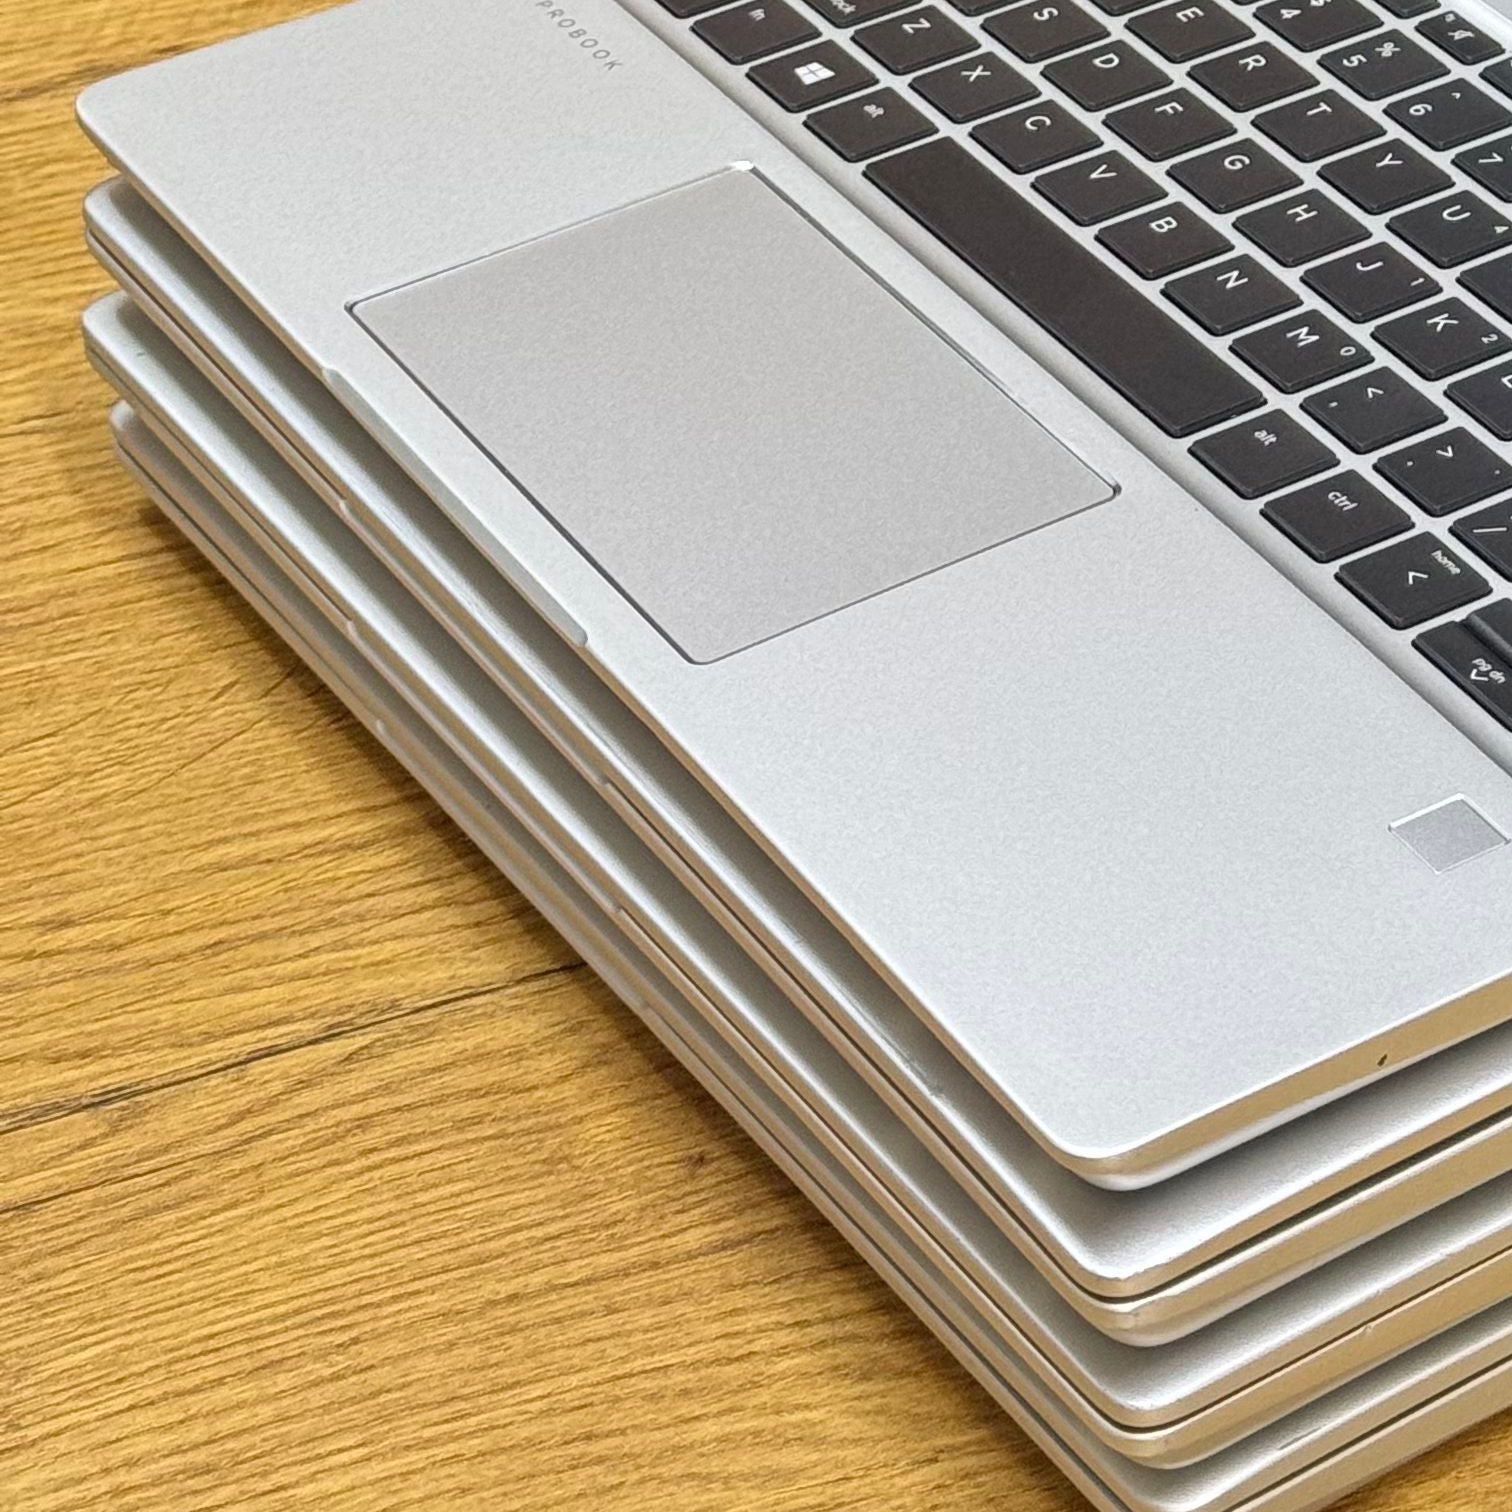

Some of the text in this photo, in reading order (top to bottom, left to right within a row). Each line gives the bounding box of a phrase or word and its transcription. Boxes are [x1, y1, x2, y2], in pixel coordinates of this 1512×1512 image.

[1032, 7, 1059, 21] S
[1175, 6, 1205, 23] E
[1279, 8, 1302, 20] 4
[901, 17, 932, 35] Z
[535, 0, 624, 71] PROBOOK
[1374, 41, 1401, 58] %
[1092, 52, 1120, 69] D
[1238, 54, 1267, 72] R
[1342, 54, 1368, 68] 5
[960, 64, 992, 83] X
[1154, 101, 1184, 115] F
[1306, 101, 1333, 116] T
[1408, 103, 1433, 116] 6
[1024, 115, 1052, 131] C
[1223, 154, 1251, 171] G
[1375, 152, 1404, 168] Y
[1478, 152, 1504, 164] 7
[1089, 164, 1118, 180] V
[1286, 203, 1318, 223] H
[1441, 204, 1472, 222] U
[1148, 216, 1178, 234] B
[1355, 261, 1384, 272] J
[1216, 270, 1249, 290] N
[1426, 313, 1459, 333] K
[1285, 326, 1320, 348] M
[1253, 429, 1278, 447] alt
[1327, 491, 1359, 512] ctrl
